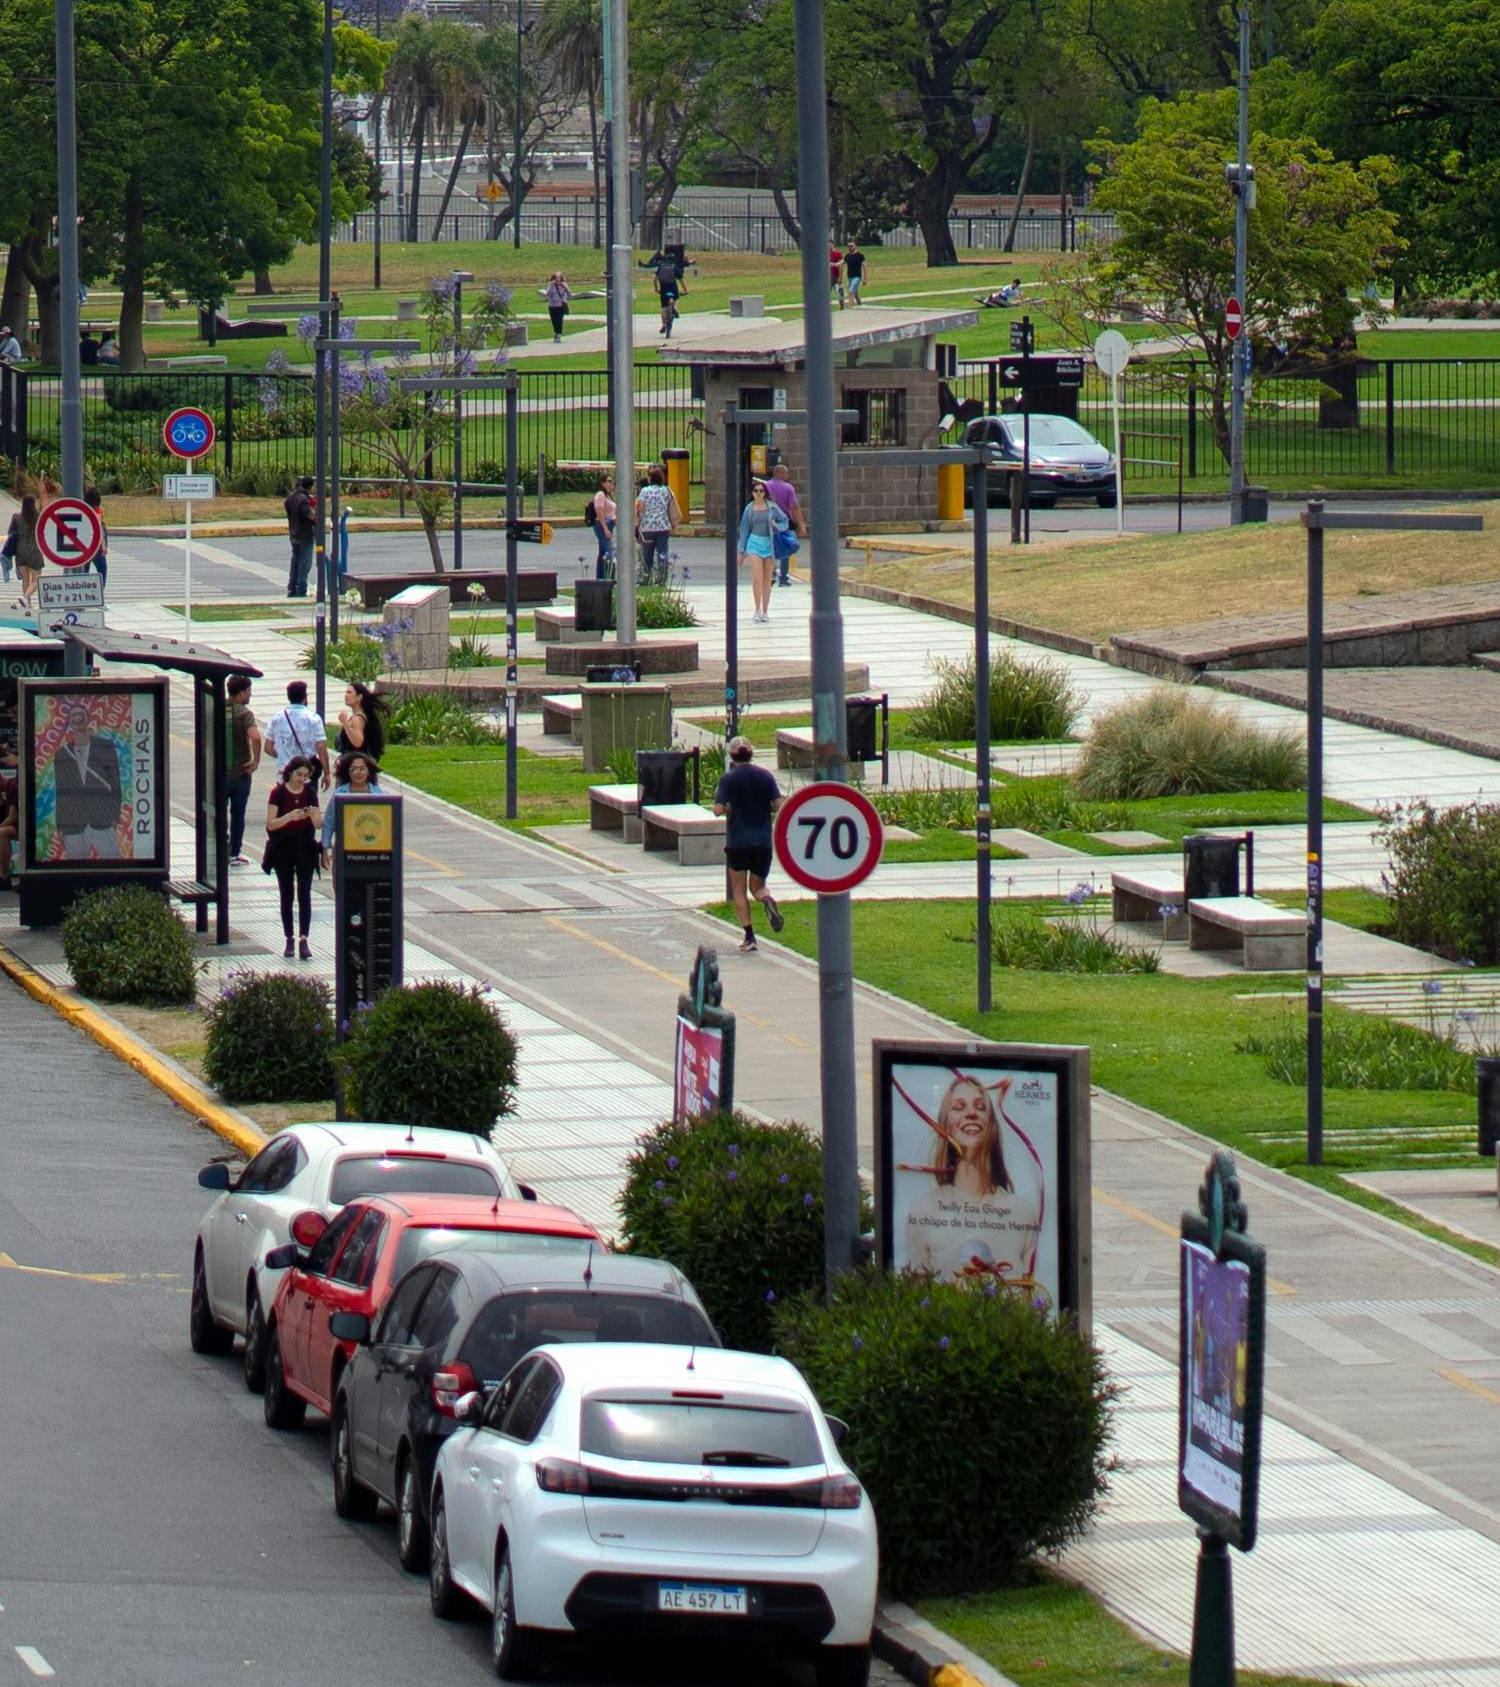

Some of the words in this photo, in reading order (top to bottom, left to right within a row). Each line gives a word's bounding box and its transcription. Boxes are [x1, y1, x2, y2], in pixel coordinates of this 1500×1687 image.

[43, 592, 54, 602] de
[56, 593, 62, 602] 7
[71, 593, 82, 602] 21
[135, 718, 150, 835] ROCHAS
[798, 815, 859, 860] 70
[964, 1202, 981, 1213] Eau
[983, 1202, 1012, 1217] Ginger
[908, 1216, 917, 1225] la
[919, 1216, 948, 1229] chispa
[949, 1217, 962, 1227] de
[964, 1218, 977, 1228] las
[979, 1219, 1006, 1230] chicas
[664, 1591, 682, 1607] AE
[688, 1592, 717, 1609] 457
[723, 1594, 741, 1610] LT
